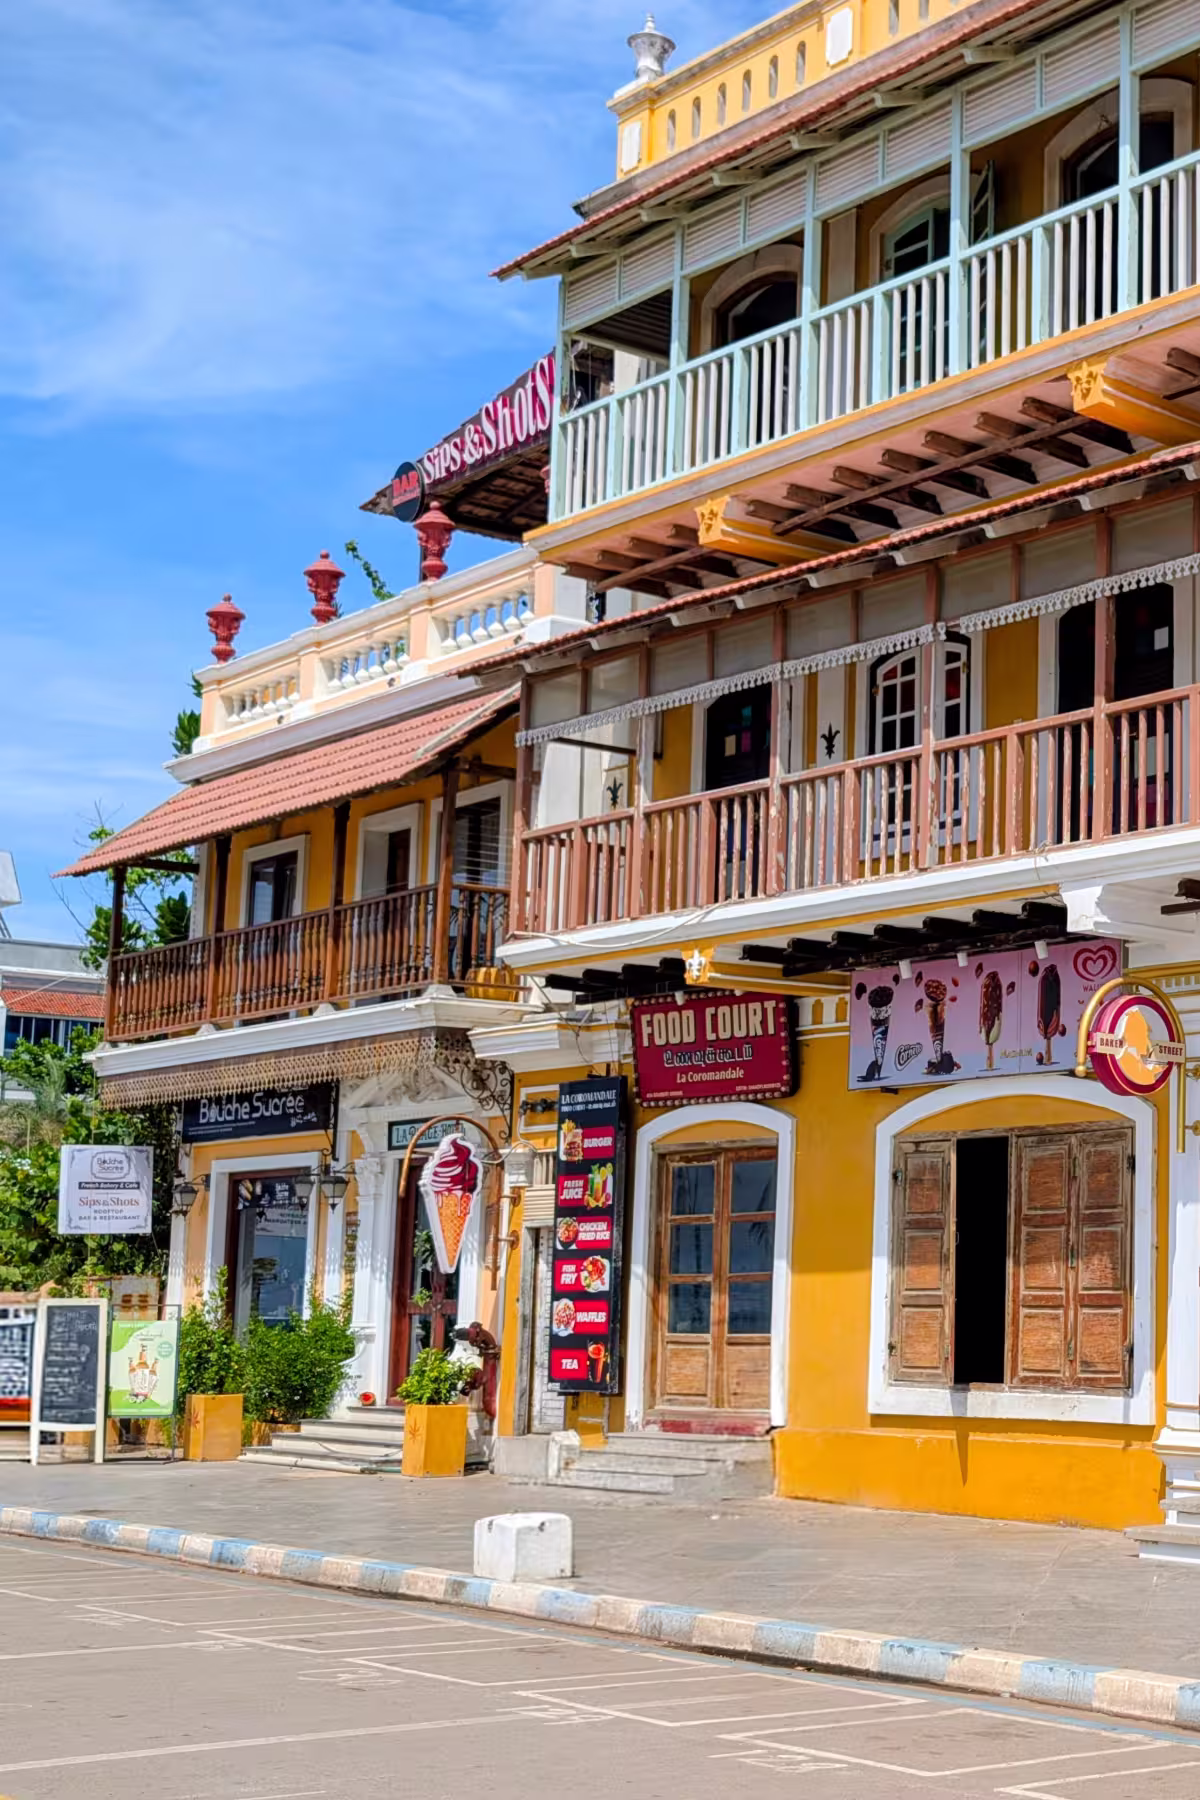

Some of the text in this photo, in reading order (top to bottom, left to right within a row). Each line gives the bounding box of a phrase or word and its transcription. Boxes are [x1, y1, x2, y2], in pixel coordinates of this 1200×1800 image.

[463, 424, 483, 464] &
[392, 472, 419, 497] BAR
[640, 1000, 777, 1048] FOOD COURT
[1099, 1037, 1183, 1057] BAKER STREET
[676, 1066, 745, 1084] La Coromandale
[561, 1089, 617, 1105] LA COROMANDALE
[199, 1091, 250, 1124] Bouche
[583, 1137, 613, 1149] BURGER
[563, 1180, 584, 1188] FRESH
[560, 1188, 583, 1200] JUICE
[79, 1196, 101, 1208] Sips
[110, 1196, 140, 1206] Shots
[579, 1221, 608, 1231] CHICKEN
[578, 1231, 611, 1241] FRIED RICE
[561, 1264, 577, 1273] FISH
[560, 1273, 578, 1285] FRY
[575, 1311, 607, 1323] WAFFLES
[561, 1359, 579, 1370] TEA
